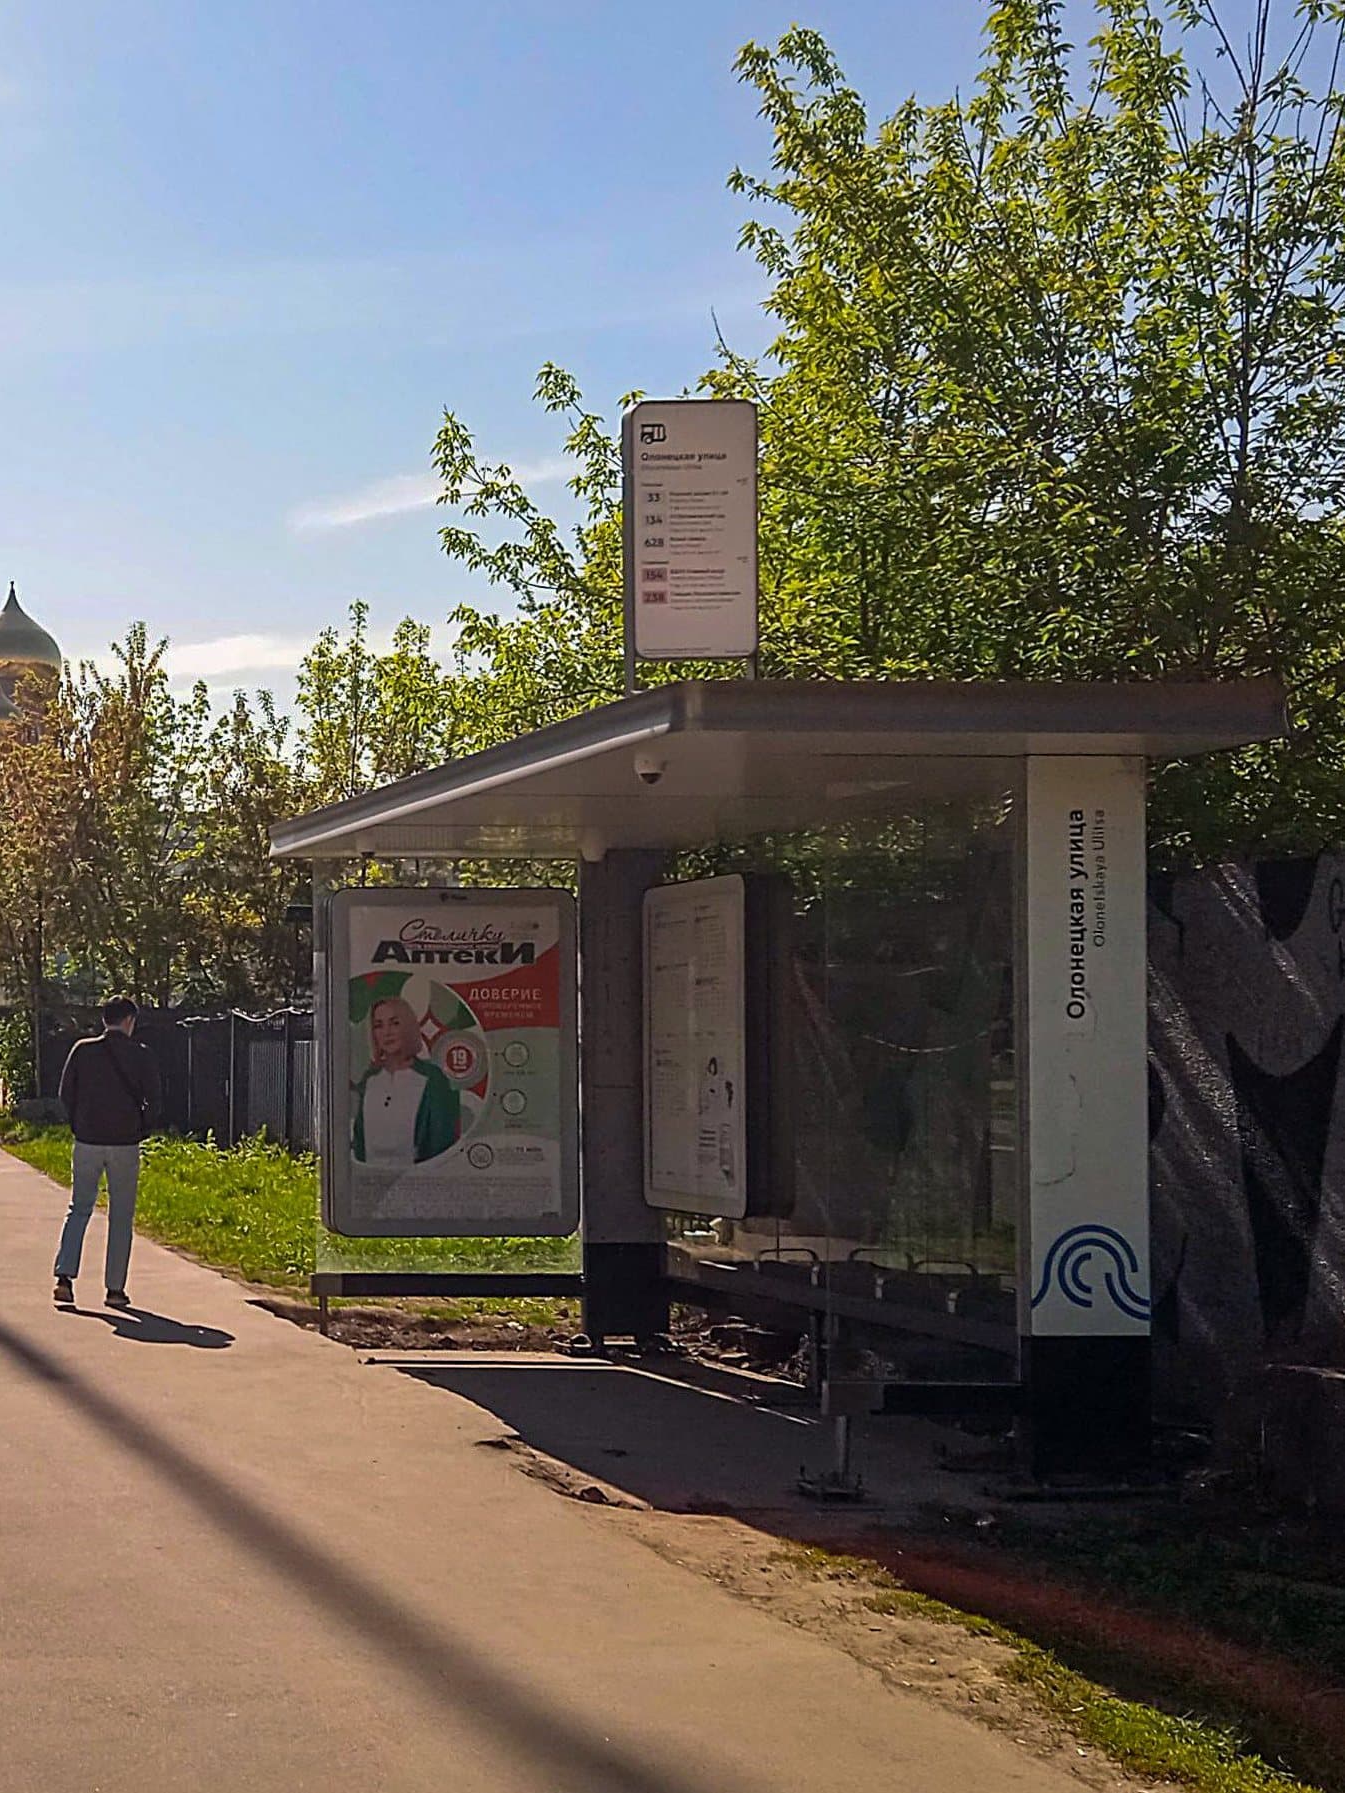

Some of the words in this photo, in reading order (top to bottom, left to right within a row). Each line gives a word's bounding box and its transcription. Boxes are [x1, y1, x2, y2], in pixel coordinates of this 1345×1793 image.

[1069, 809, 1088, 880] улица
[1093, 809, 1105, 850] Ulitsa
[1093, 856, 1107, 948] Olonetskaya
[399, 917, 506, 943] Столички
[1066, 887, 1087, 1019] Олонецкая
[469, 987, 542, 1001] ДОВЕРИЕ
[451, 1049, 467, 1065] 19
